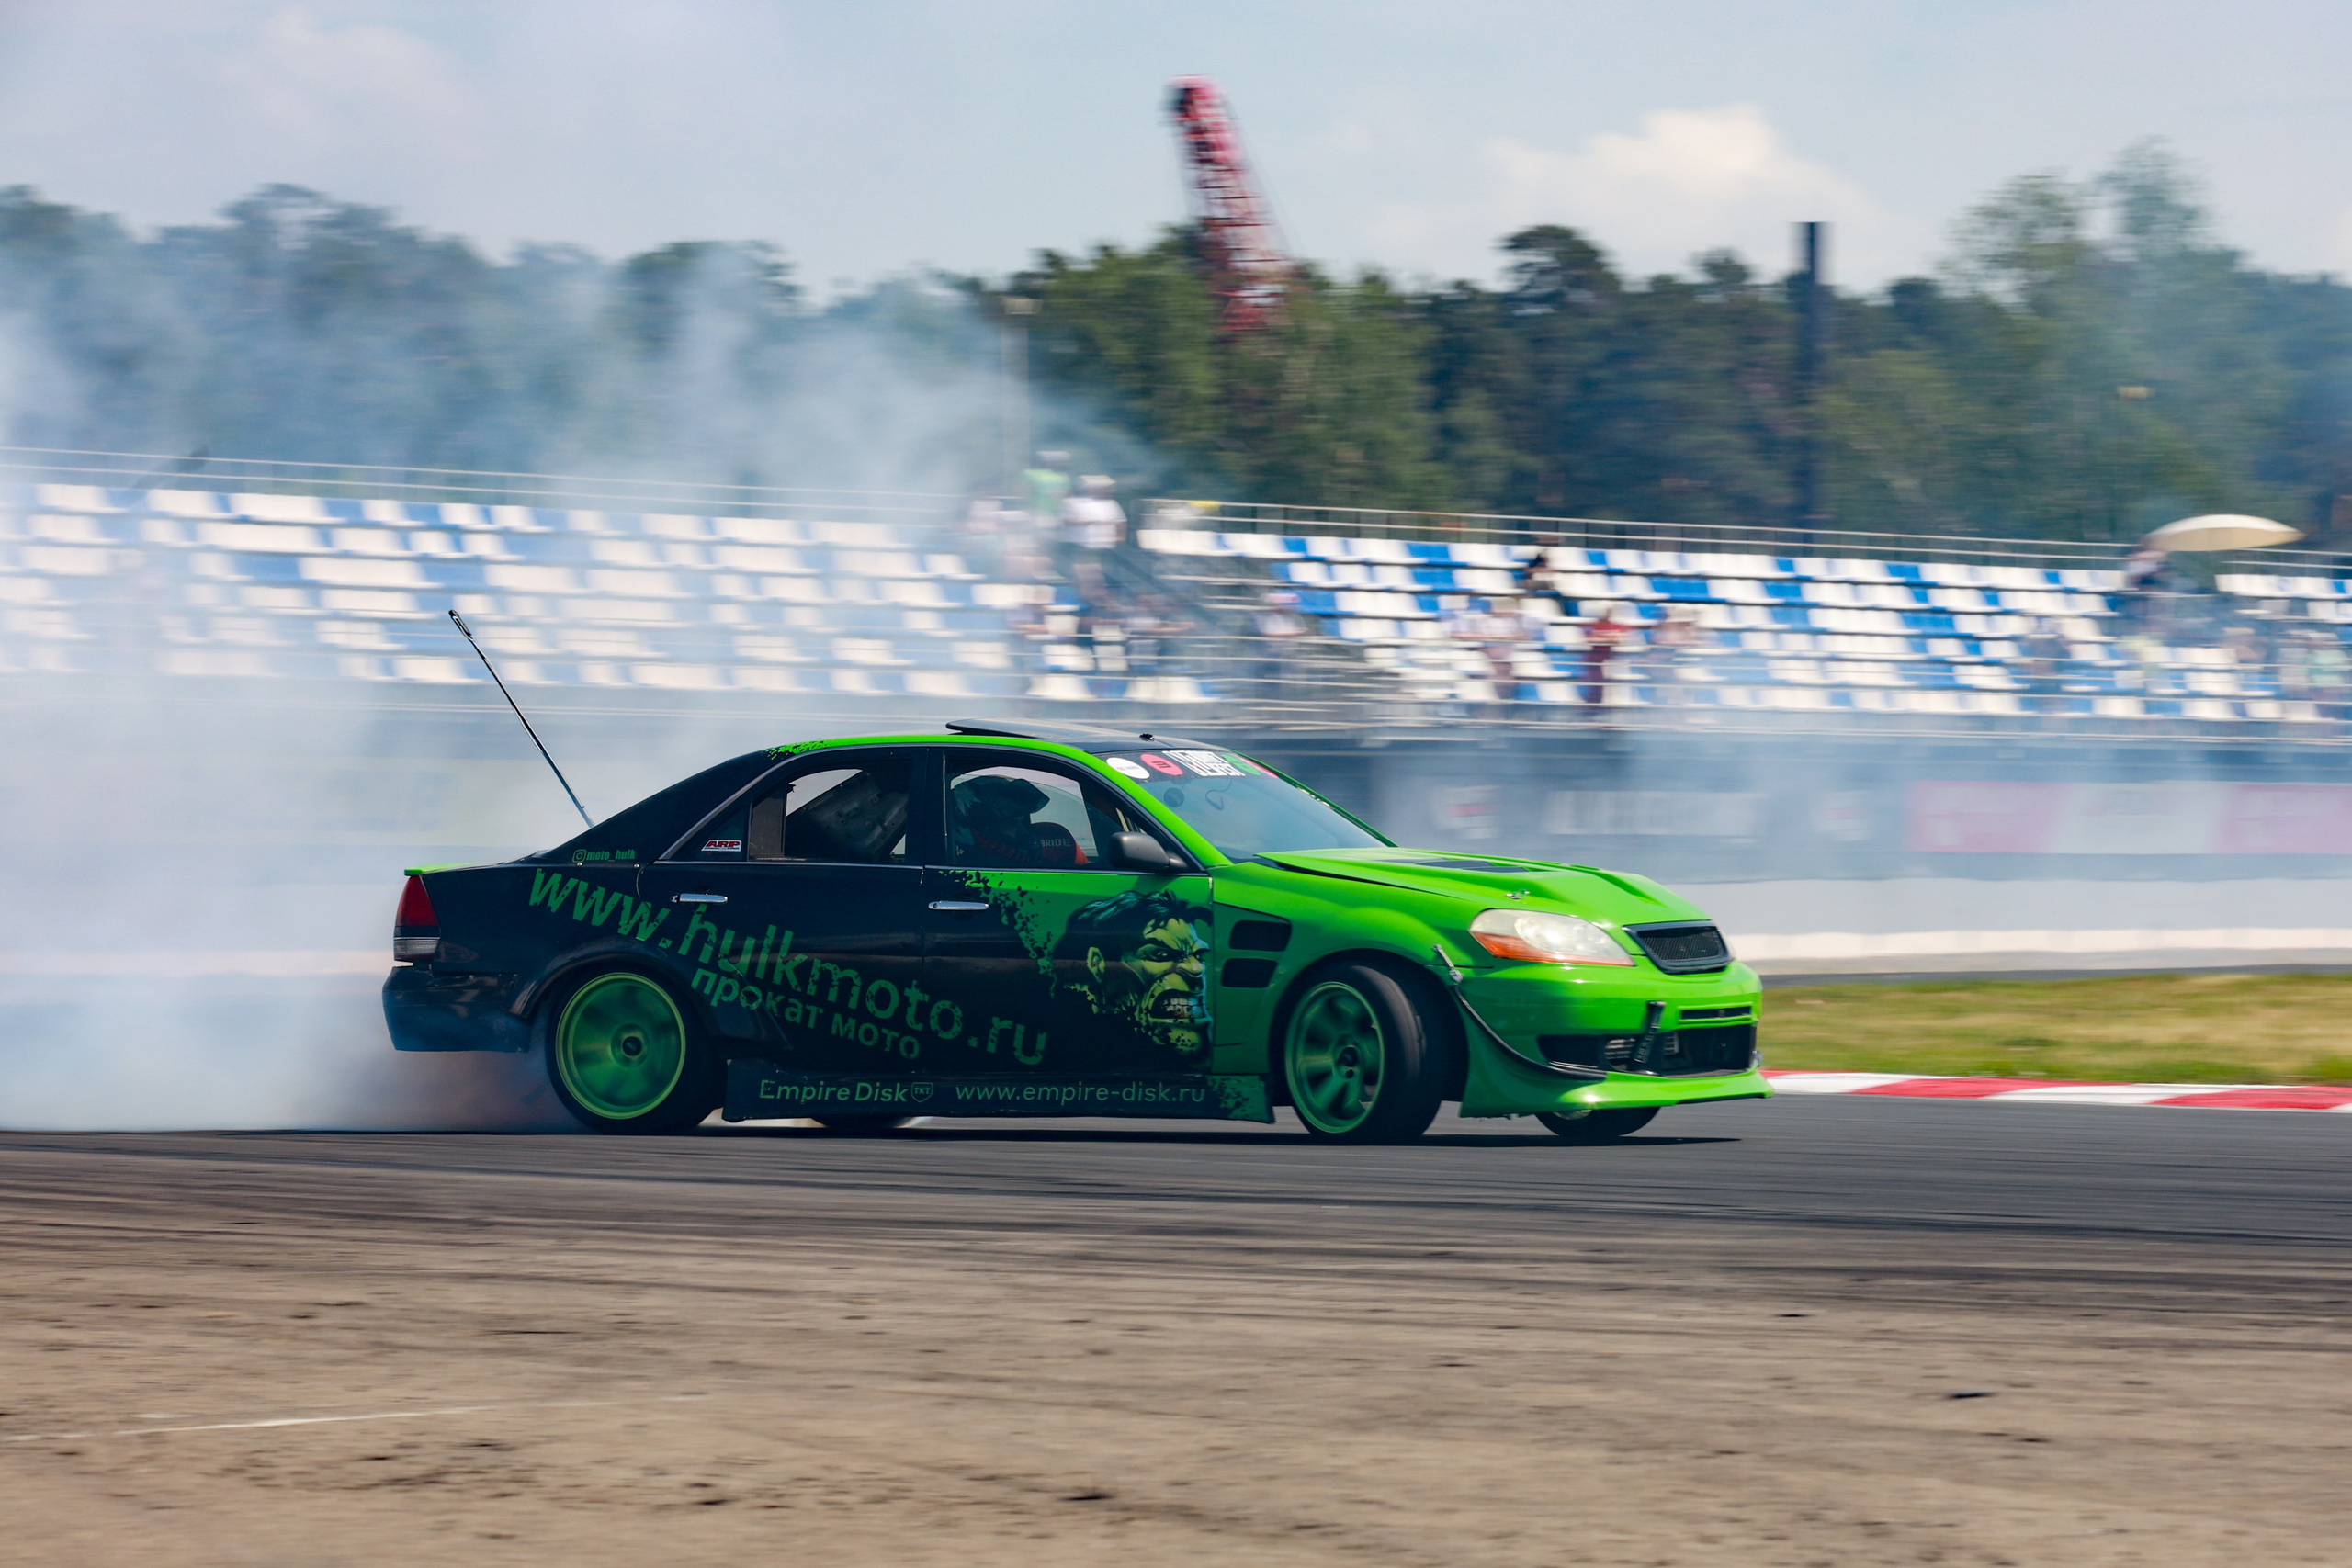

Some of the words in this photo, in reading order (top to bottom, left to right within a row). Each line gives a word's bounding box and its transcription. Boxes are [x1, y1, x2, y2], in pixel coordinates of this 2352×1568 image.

[586, 849, 636, 862] moto_hulk
[529, 868, 1047, 1066] www.hulkmoto.ru
[691, 968, 824, 1029] прокат
[956, 1081, 1205, 1106] www.empire-disk.ru
